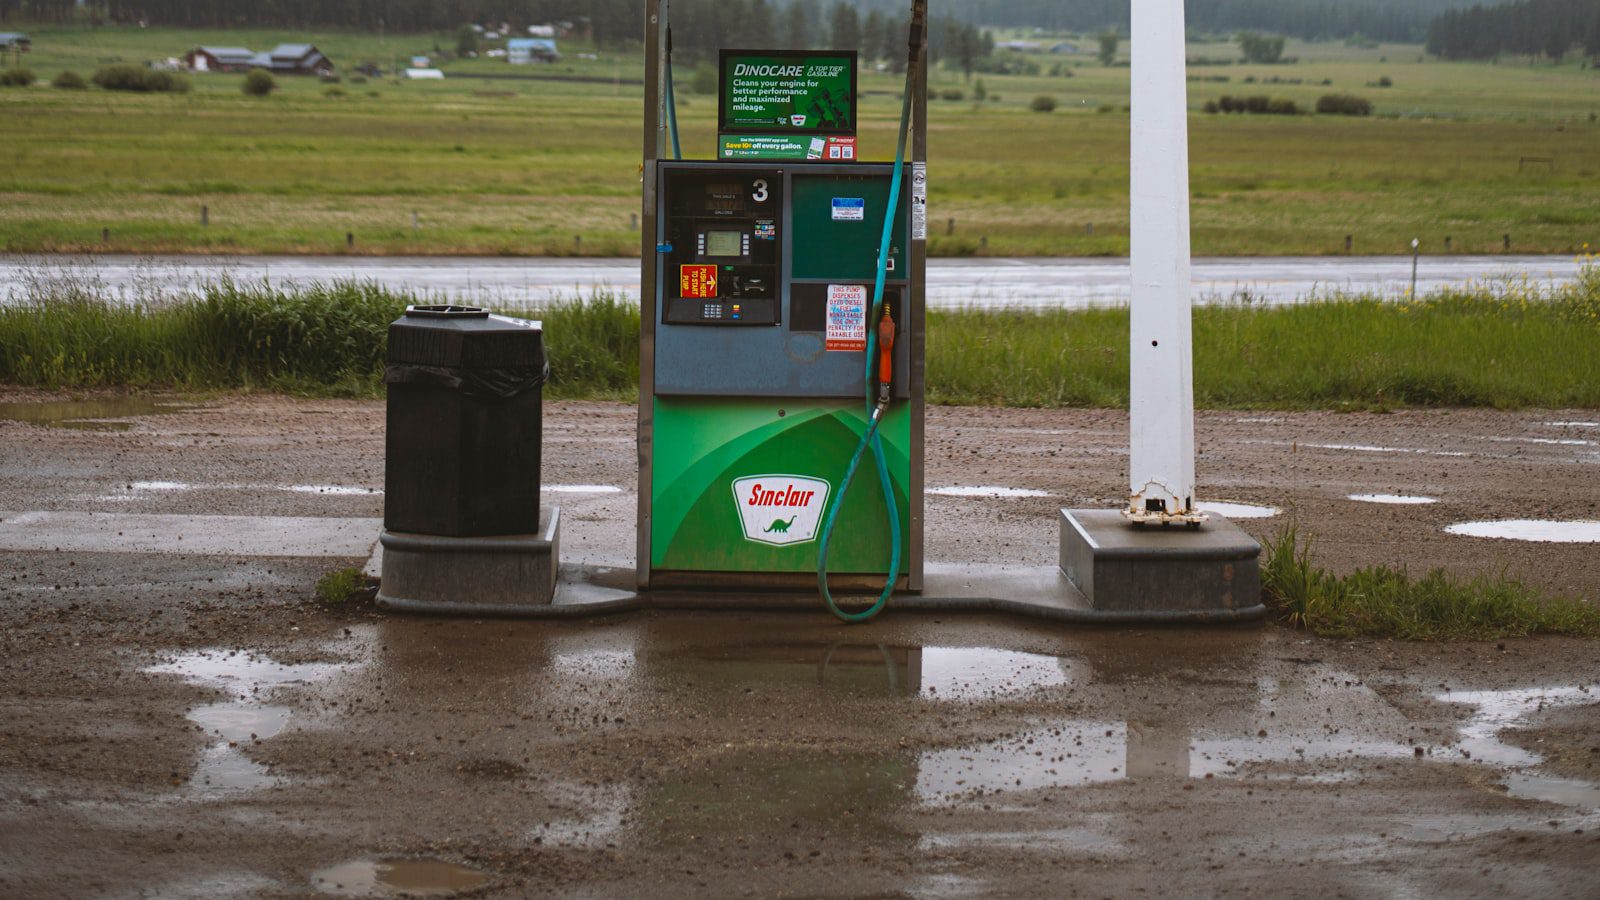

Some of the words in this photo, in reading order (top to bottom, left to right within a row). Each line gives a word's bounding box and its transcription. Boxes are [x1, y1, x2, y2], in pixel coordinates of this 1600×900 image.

[734, 64, 804, 76] DINOCARE
[758, 87, 808, 96] performance
[733, 104, 765, 112] mileage.
[752, 179, 768, 202] 3
[749, 484, 814, 507] Sinclair
